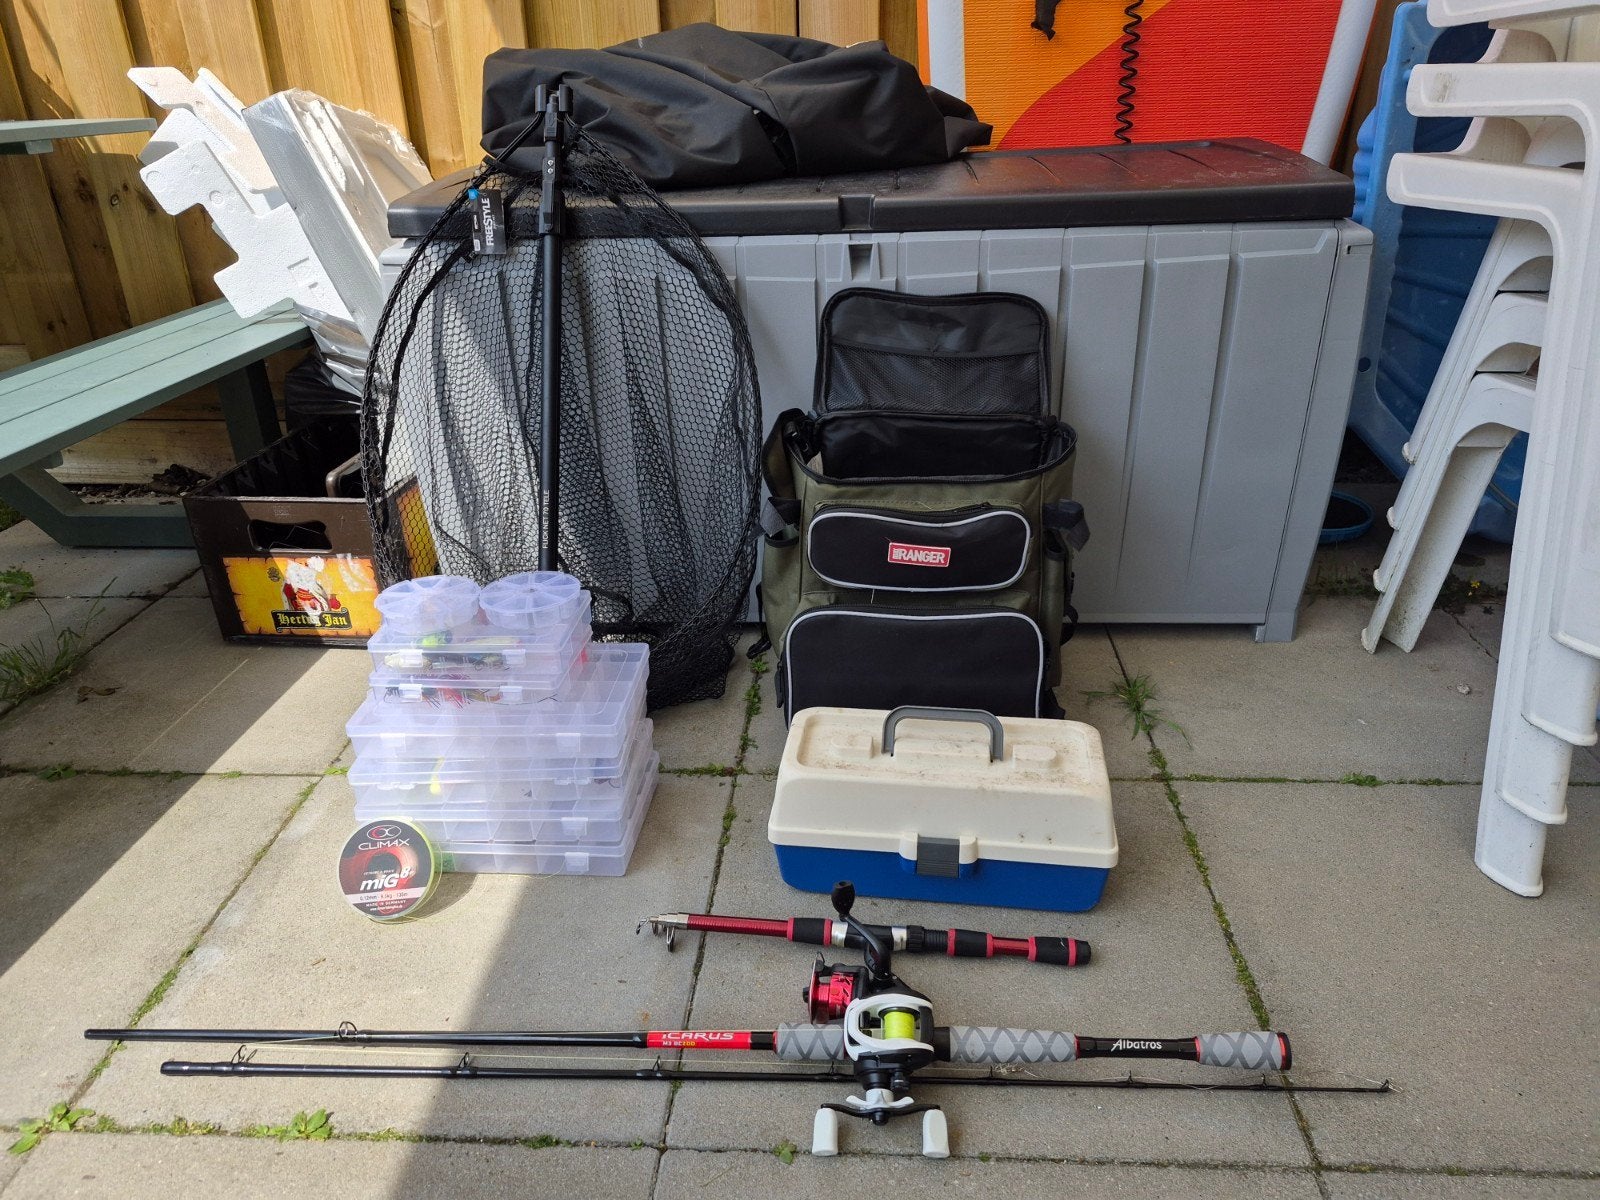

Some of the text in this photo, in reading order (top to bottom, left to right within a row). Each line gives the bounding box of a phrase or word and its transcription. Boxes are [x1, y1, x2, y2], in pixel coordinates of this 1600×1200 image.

[481, 197, 494, 246] FREESTYLE
[898, 548, 945, 563] RANGER
[323, 613, 348, 627] Jan
[358, 838, 410, 851] CLIMAX
[1110, 1039, 1163, 1052] Albatros
